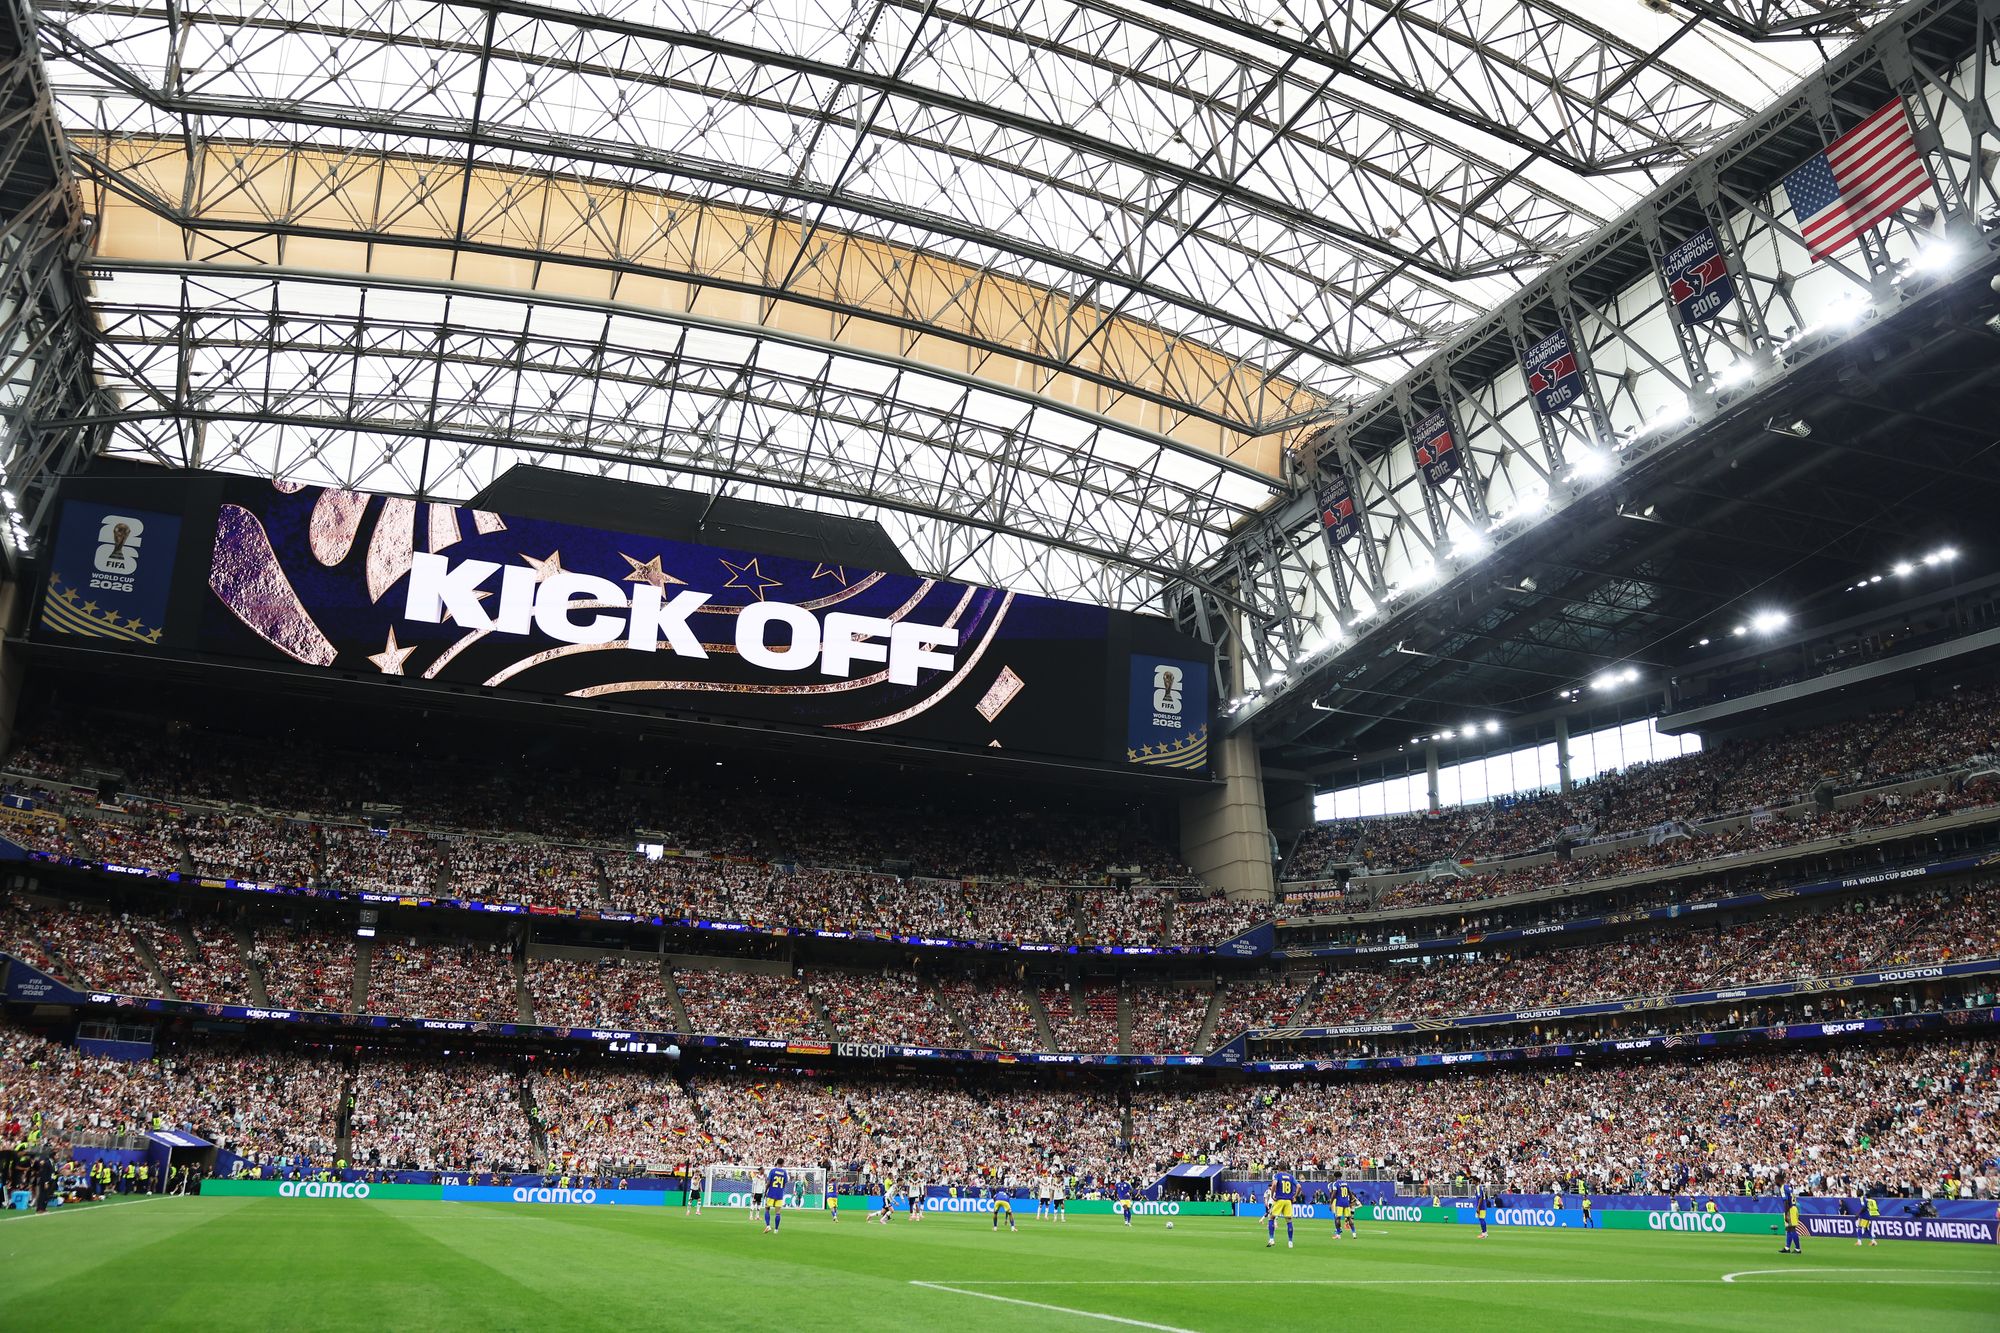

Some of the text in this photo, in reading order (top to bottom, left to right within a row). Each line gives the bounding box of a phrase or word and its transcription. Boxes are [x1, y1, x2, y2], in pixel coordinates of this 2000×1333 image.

[1669, 233, 1706, 264] AFC SOUTH
[1666, 238, 1714, 276] CHAMPIONS
[1691, 291, 1720, 319] 2016
[1528, 333, 1560, 359] AFC SOUTH
[1525, 338, 1567, 370] CHAMPIONS
[1546, 384, 1572, 409] 2015
[1416, 412, 1441, 435] AFC SOUTH
[1413, 419, 1445, 445] CHAMPIONS
[1430, 460, 1450, 481] 2012
[1335, 524, 1351, 541] 2011
[106, 560, 125, 569] FIFA
[91, 572, 119, 581] WORLD
[89, 579, 133, 593] 2026
[404, 550, 960, 687] KICK OFF
[1152, 719, 1182, 729] 2026
[107, 864, 144, 875] KICK OFF
[1842, 868, 1926, 888] FIFA WORLD CUP 2026
[1522, 924, 1564, 936] HOUSTON
[1368, 945, 1388, 953] WORLD
[1879, 967, 1943, 982] HOUSTON
[92, 994, 111, 1003] OFF
[246, 1009, 290, 1019] KICK OFF
[1516, 1009, 1561, 1019] HOUSTON
[424, 1021, 466, 1030] KICK OFF
[1822, 1023, 1865, 1033] KICK OFF
[592, 1031, 612, 1039] KICK
[749, 1040, 786, 1048] KICK OFF
[837, 1042, 886, 1058] KETSCH
[1616, 1041, 1635, 1050] KICK
[441, 1177, 460, 1185] IFA
[772, 1175, 784, 1188] 24
[1281, 1180, 1291, 1194] 18
[279, 1181, 370, 1198] aramco
[513, 1187, 596, 1204] aramco
[1113, 1201, 1180, 1215] aamco
[1373, 1206, 1422, 1222] aramco
[1495, 1209, 1555, 1226] aramco
[1648, 1211, 1726, 1232] aramco
[1810, 1219, 1854, 1236] UNITED
[1904, 1221, 1922, 1237] OF
[1925, 1223, 1992, 1240] AMERICA
